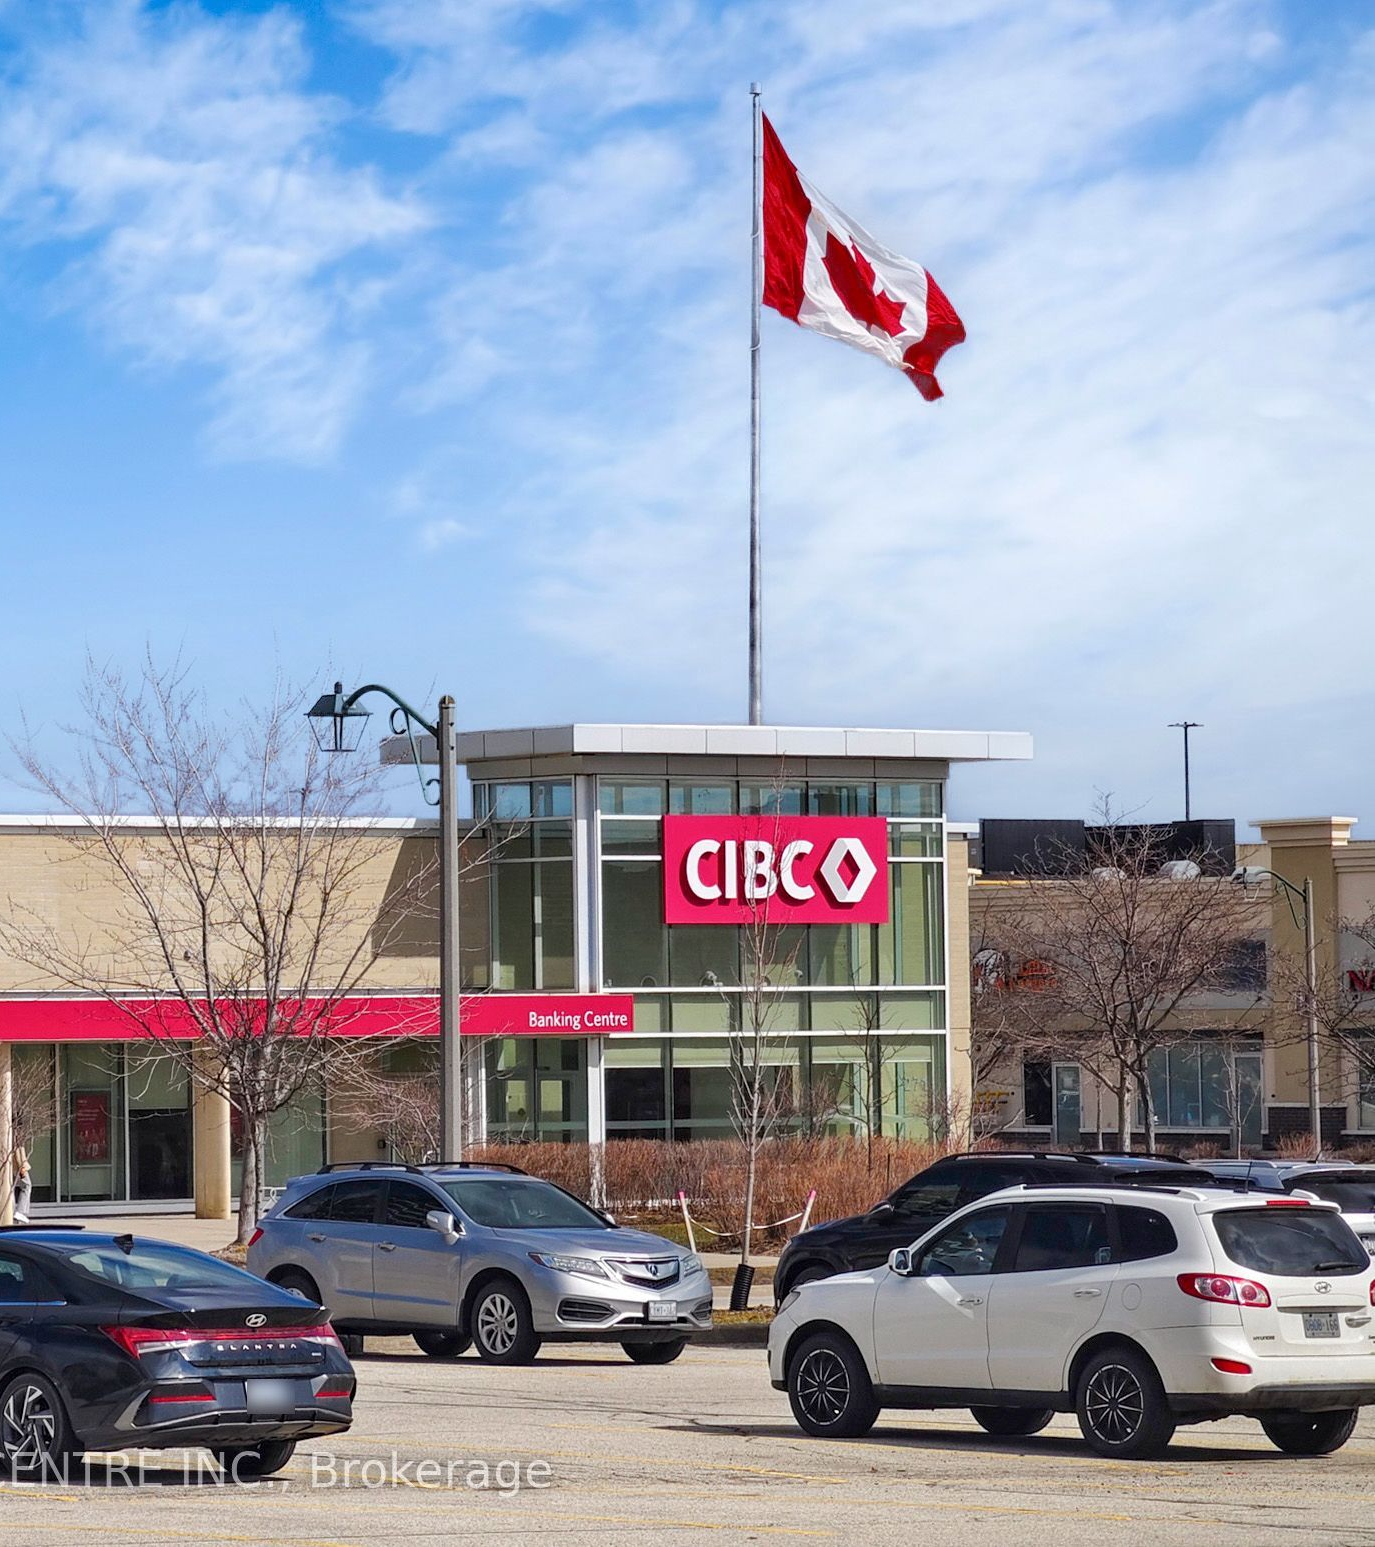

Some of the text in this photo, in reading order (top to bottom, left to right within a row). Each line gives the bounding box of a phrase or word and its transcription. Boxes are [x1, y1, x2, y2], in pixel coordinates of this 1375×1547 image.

[686, 838, 815, 900] CIBC
[529, 1010, 628, 1030] Banking Centre
[217, 1343, 297, 1351] ELANTRA
